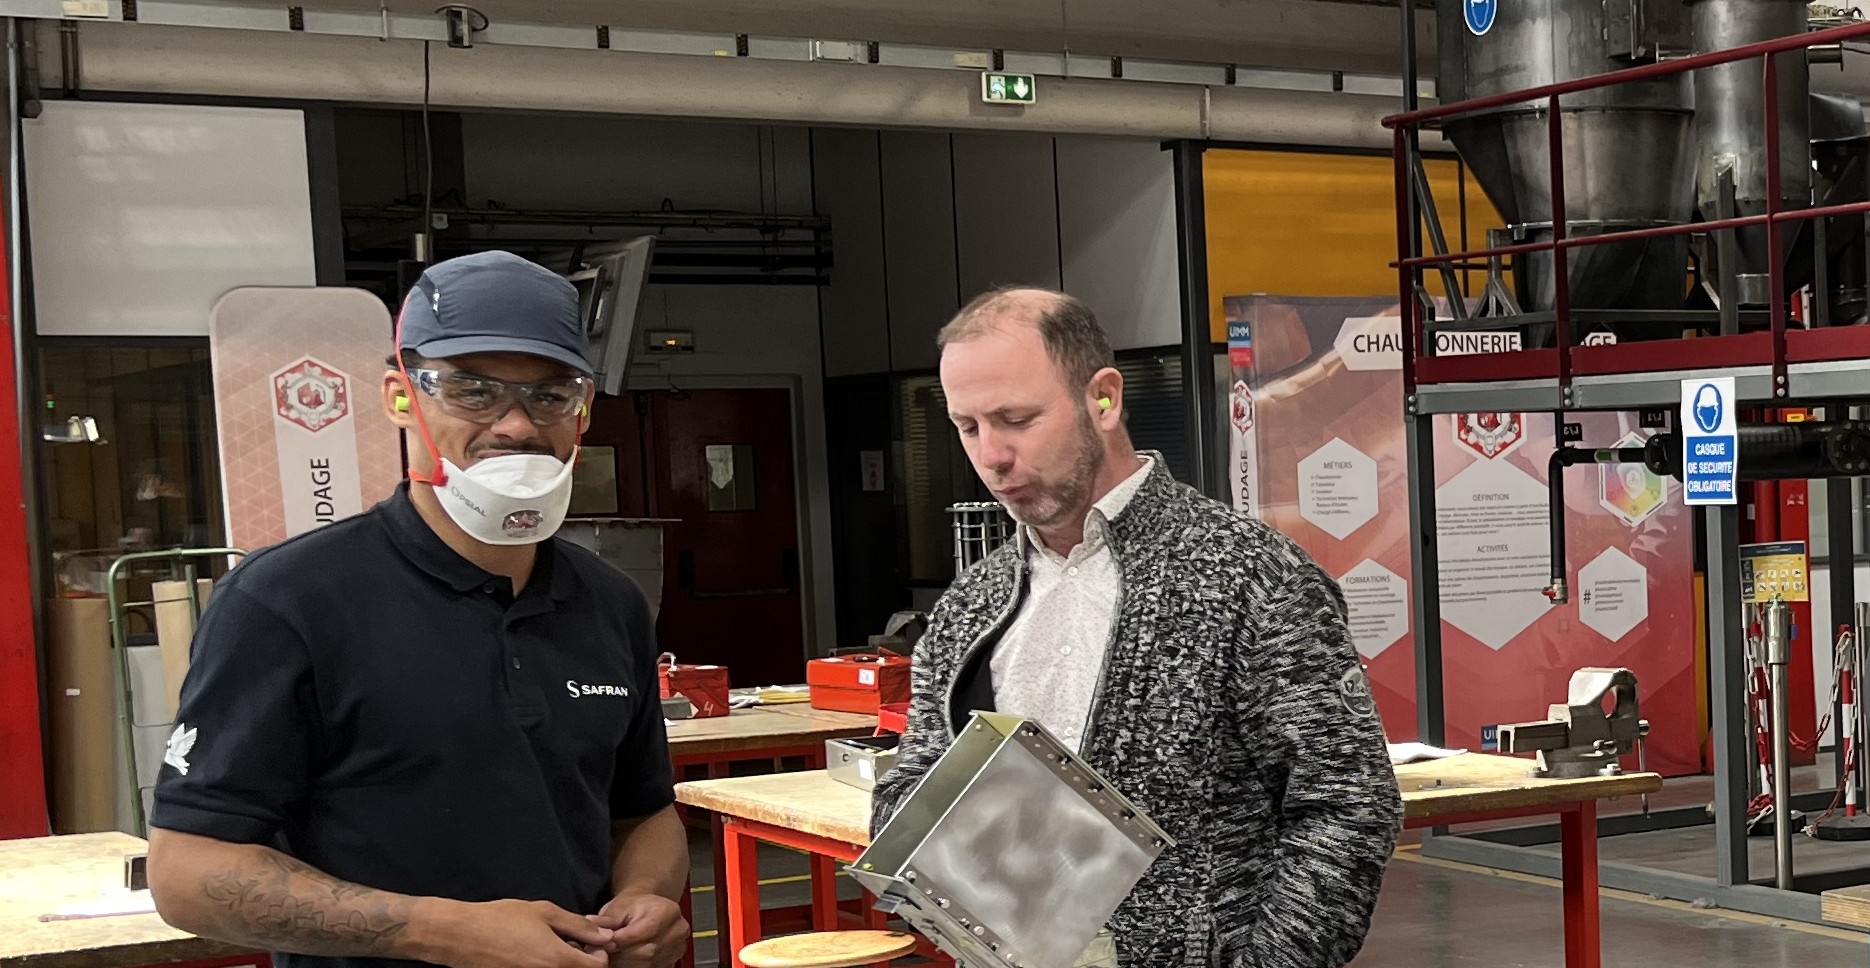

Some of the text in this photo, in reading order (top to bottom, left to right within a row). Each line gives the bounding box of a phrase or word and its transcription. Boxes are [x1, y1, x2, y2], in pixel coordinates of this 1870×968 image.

[1229, 325, 1250, 337] UIMM
[1694, 443, 1725, 456] CASQUE
[1687, 461, 1733, 474] DE SECURITE
[1239, 450, 1250, 513] UDAGE
[1687, 480, 1732, 492] OBLIGATOIRE
[1345, 575, 1391, 585] FORMATIONS
[581, 684, 628, 697] SAFRAN
